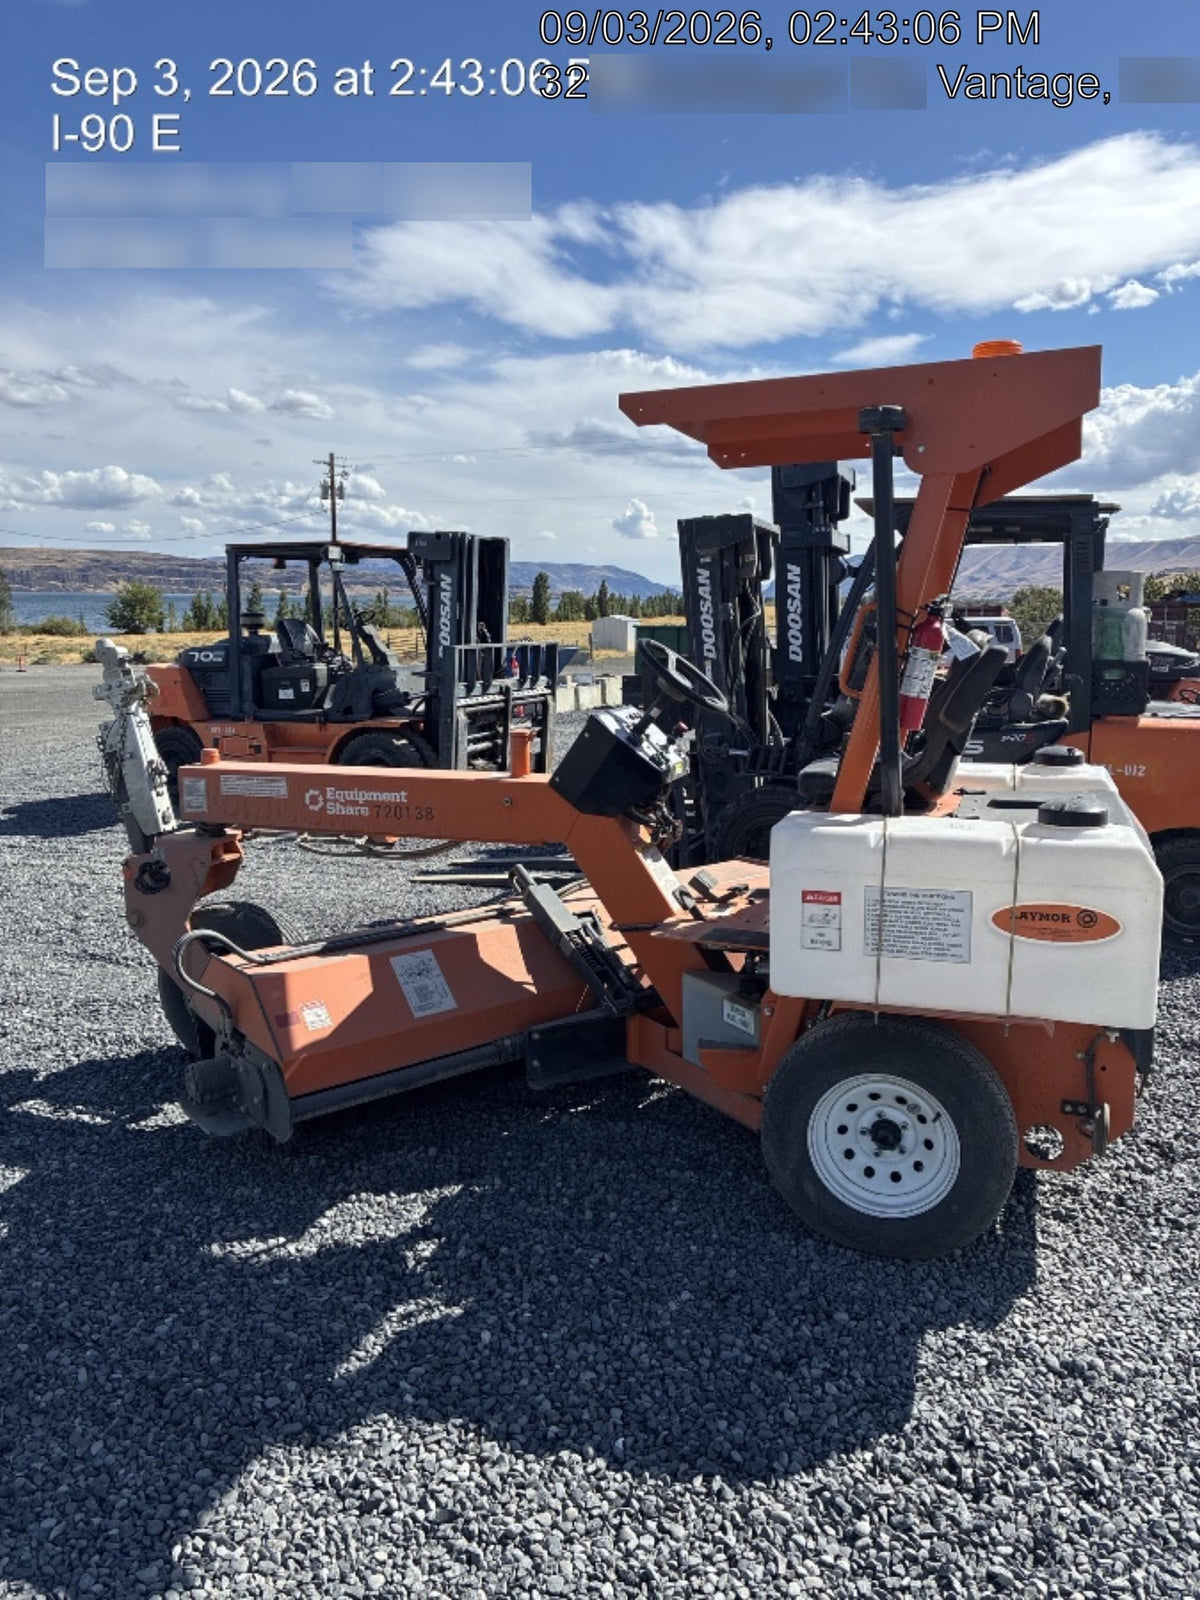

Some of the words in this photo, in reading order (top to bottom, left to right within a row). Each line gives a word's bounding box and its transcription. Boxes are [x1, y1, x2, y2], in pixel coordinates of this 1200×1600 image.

[697, 567, 717, 660] DOOSAN
[786, 563, 803, 662] DOOSAN
[325, 786, 408, 804] Equipment
[325, 801, 370, 816] Share
[373, 804, 436, 822] 720138
[1009, 911, 1071, 923] AYMOR
